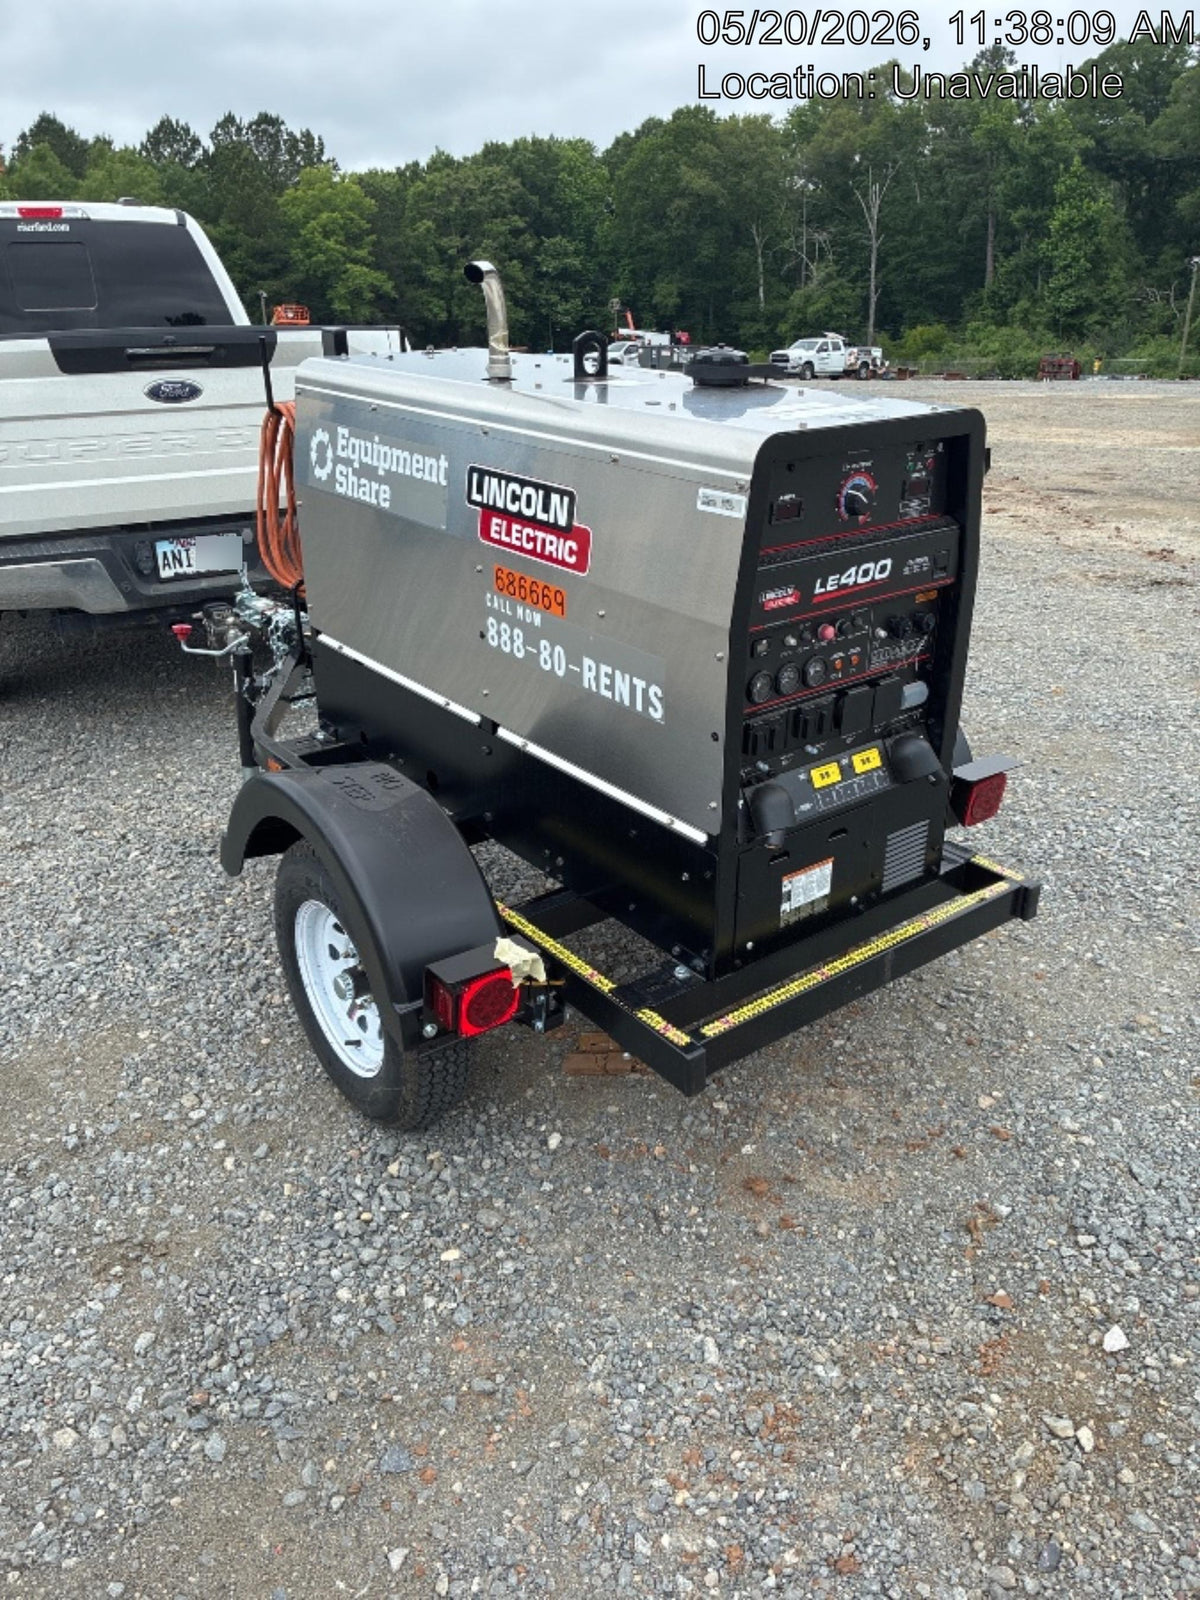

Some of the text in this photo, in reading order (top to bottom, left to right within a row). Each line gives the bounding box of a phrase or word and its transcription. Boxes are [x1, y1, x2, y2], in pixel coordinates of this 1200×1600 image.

[0, 434, 200, 464] UPER
[336, 425, 449, 487] Equipment
[335, 462, 391, 509] Share
[470, 471, 571, 528] LINCOLN
[162, 548, 193, 571] ANI
[489, 516, 579, 565] ELECTRIC
[494, 567, 566, 617] 686669
[813, 557, 893, 595] LE400
[485, 592, 542, 628] CALL NOW
[486, 615, 665, 720] 888-80-RENTS
